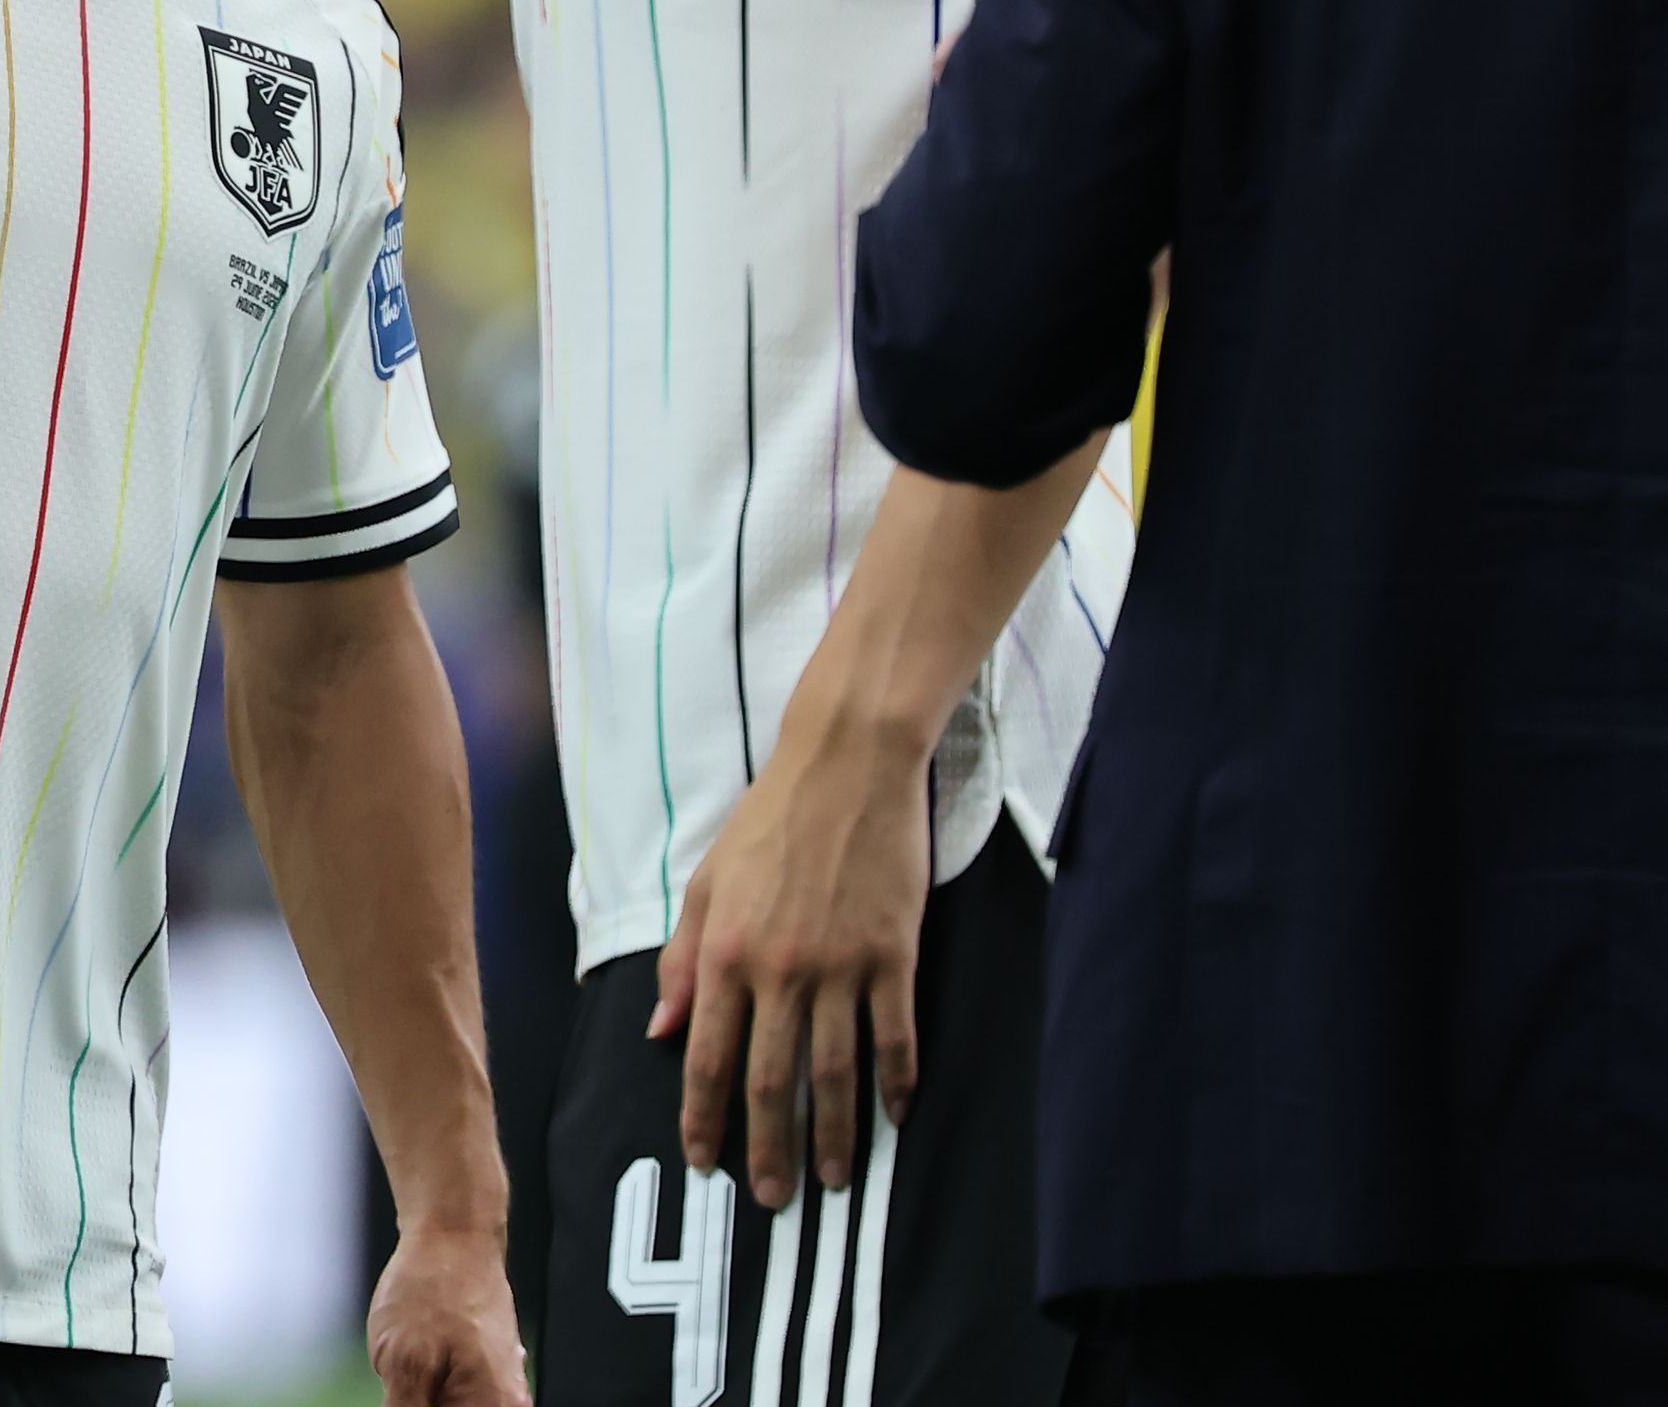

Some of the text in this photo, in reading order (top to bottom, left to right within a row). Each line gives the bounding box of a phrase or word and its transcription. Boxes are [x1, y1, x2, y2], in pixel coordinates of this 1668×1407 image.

[229, 38, 292, 70] JAPAN
[245, 164, 293, 210] JFA
[607, 1156, 736, 1407] 4
